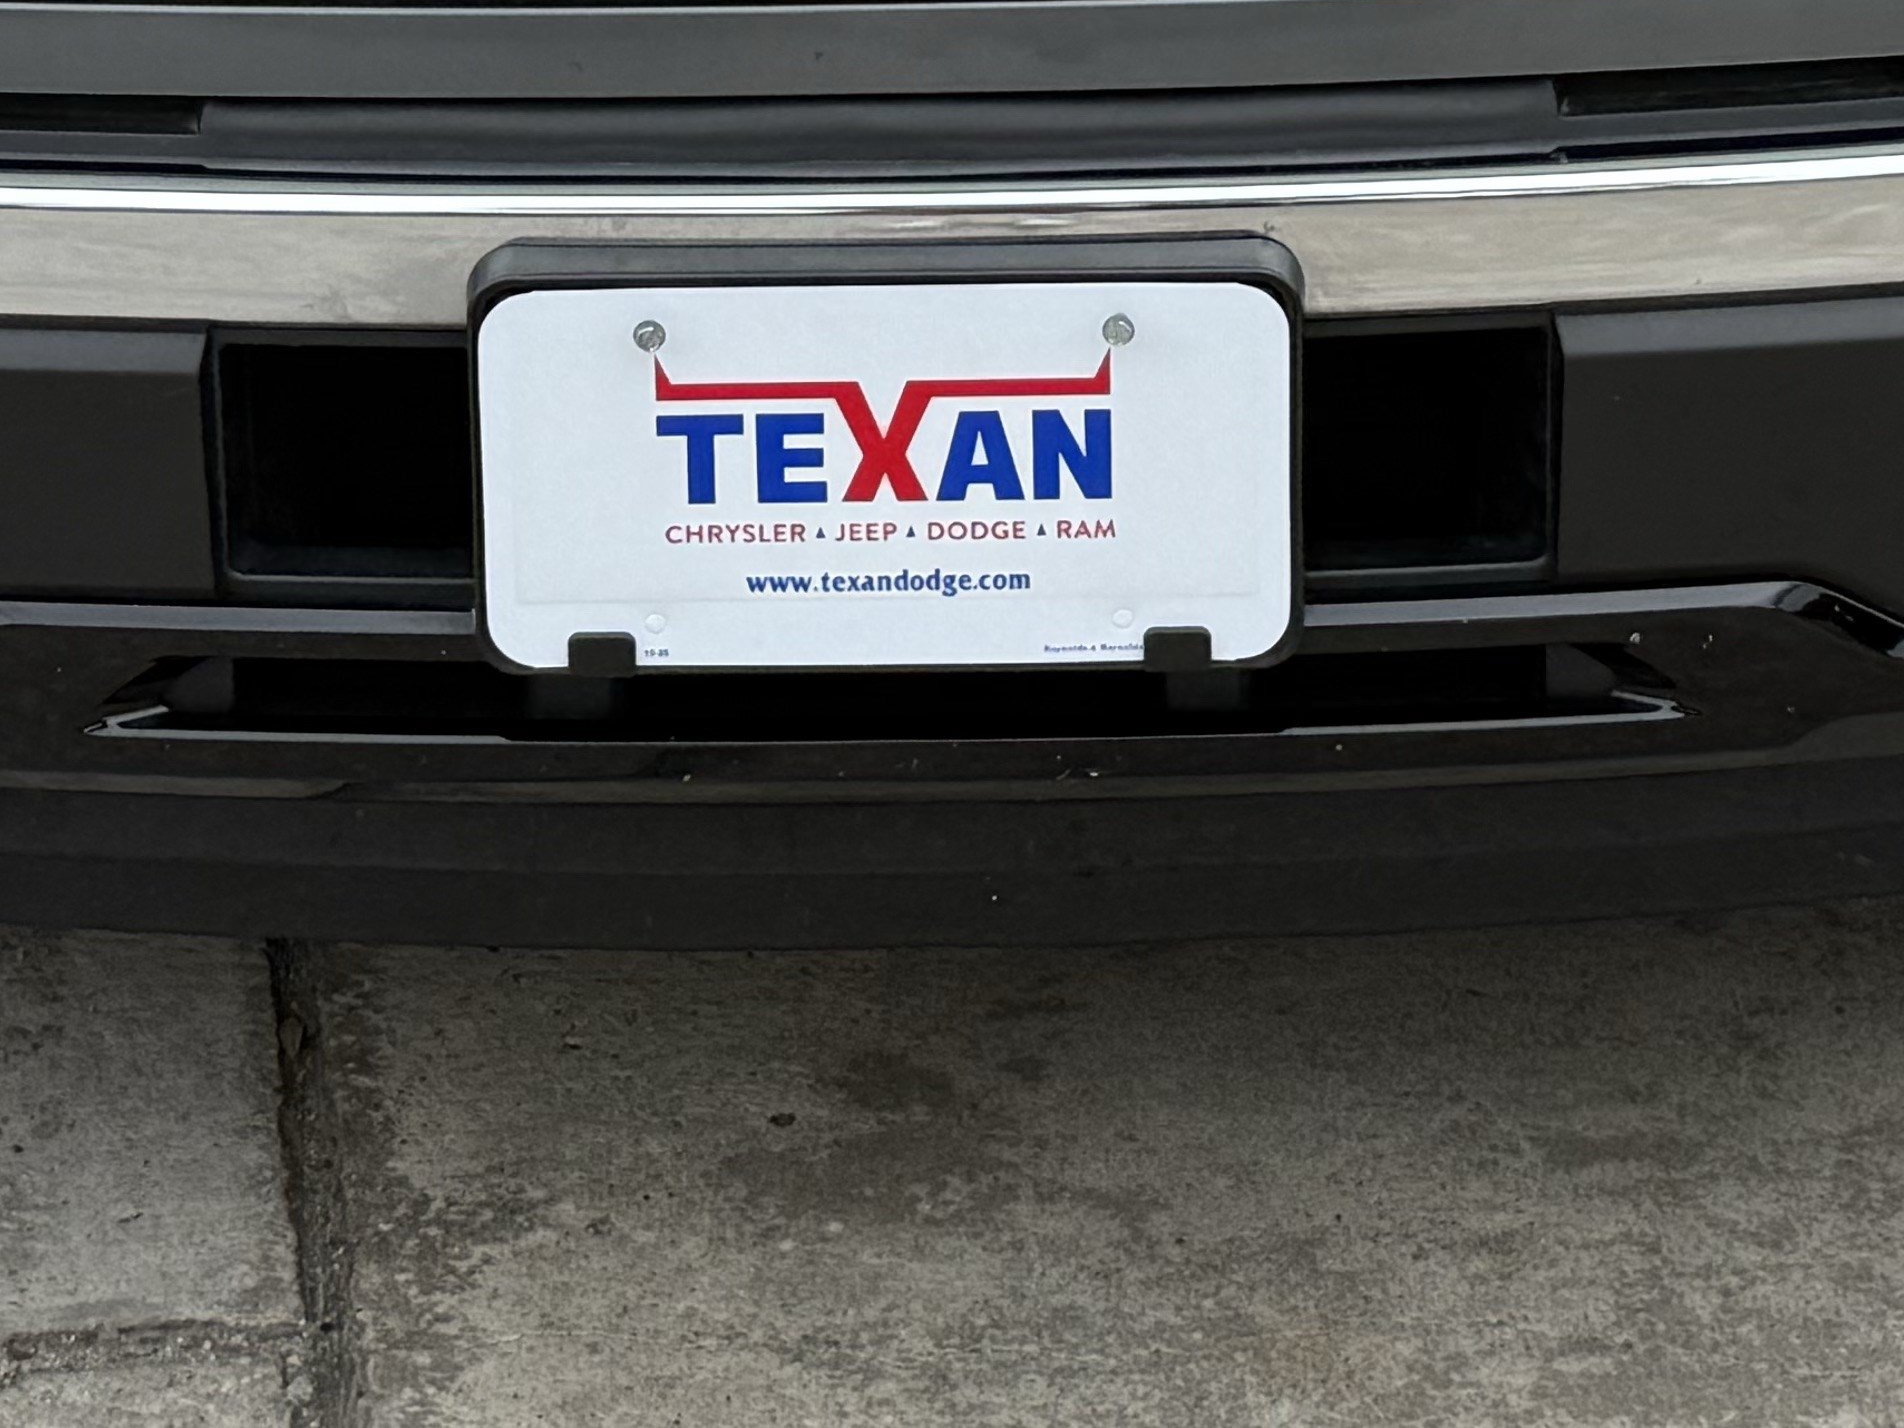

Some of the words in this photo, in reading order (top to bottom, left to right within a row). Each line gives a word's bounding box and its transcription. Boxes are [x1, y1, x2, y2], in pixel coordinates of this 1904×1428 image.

[654, 380, 1113, 505] TEXAN
[664, 522, 807, 544] CHRYSLER
[834, 521, 898, 542] JEEP
[926, 519, 1027, 541] DODGE
[1055, 518, 1117, 539] RAM
[745, 567, 1032, 597] www.texandodge.com
